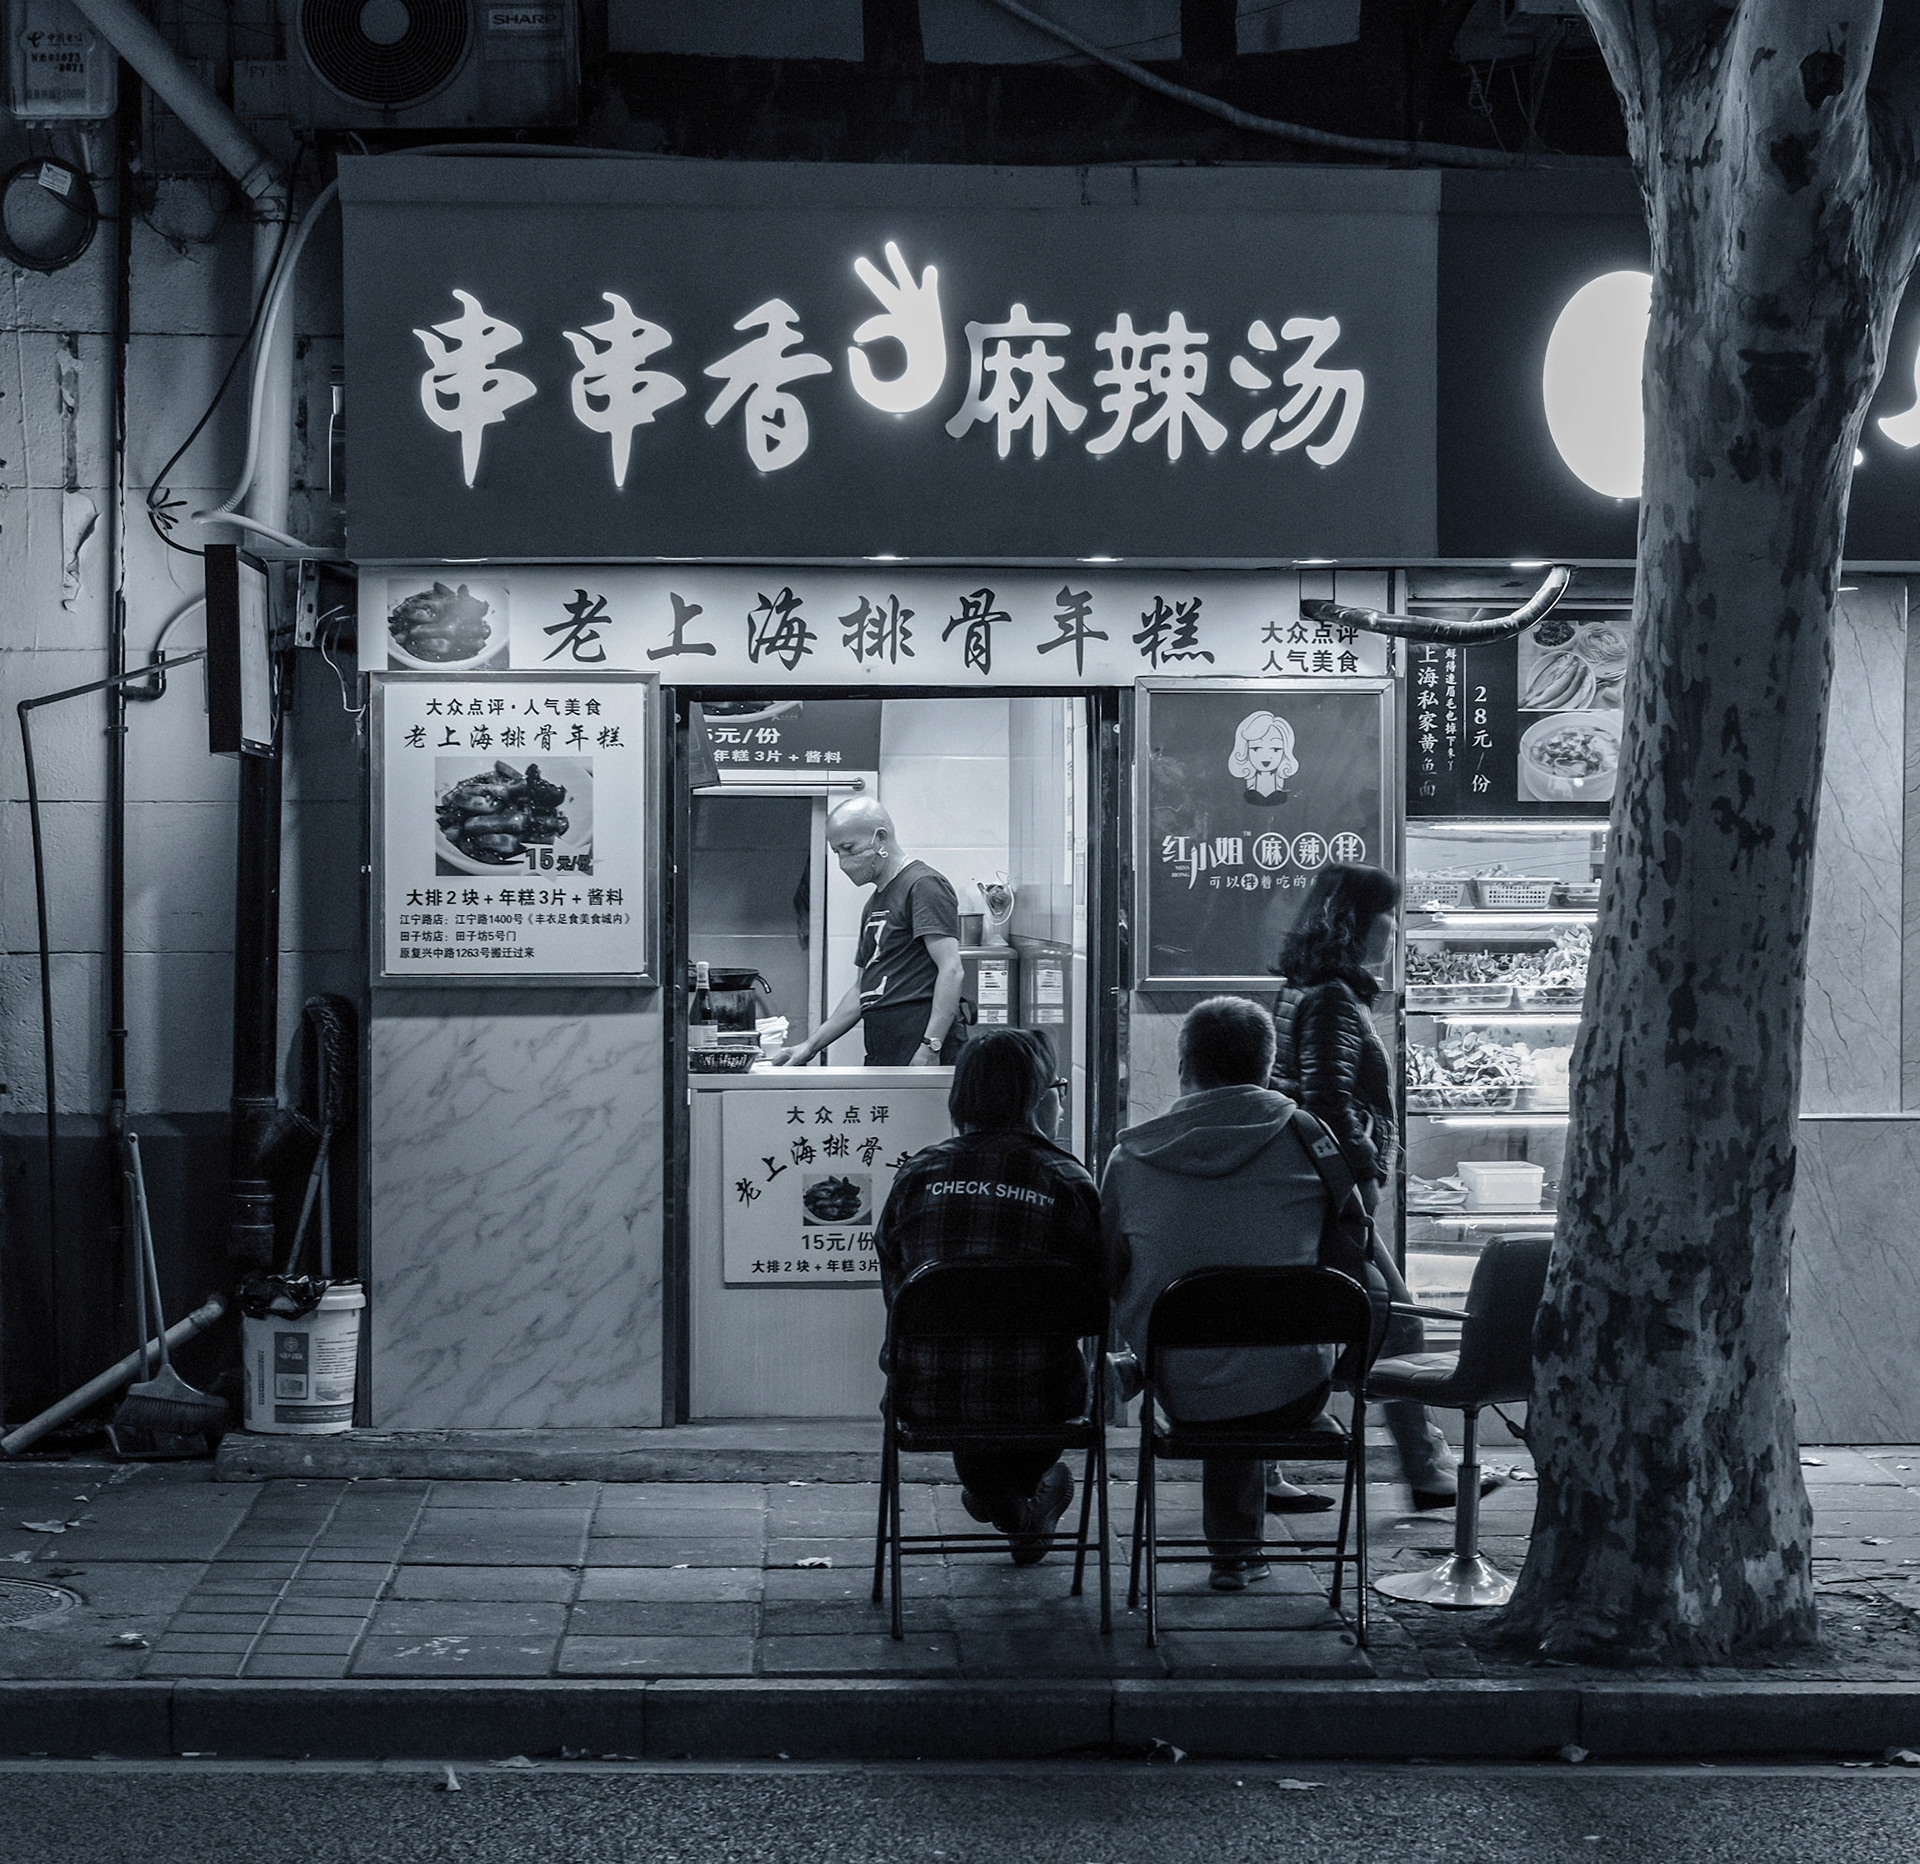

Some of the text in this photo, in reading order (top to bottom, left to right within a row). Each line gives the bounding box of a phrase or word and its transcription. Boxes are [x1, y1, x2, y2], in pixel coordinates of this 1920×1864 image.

[492, 14, 557, 25] SHARP
[413, 288, 1365, 487] 串串香 麻辣汤
[542, 585, 1215, 676] 老上海排骨年糕
[1261, 620, 1359, 645] 大众点评
[1261, 650, 1359, 673] 人气美食
[1417, 645, 1439, 796] 上海私家黄鱼面
[404, 723, 625, 751] 老上海排骨年糕
[525, 848, 591, 871] 15元/份
[1162, 835, 1244, 889] 红小姐
[1256, 835, 1362, 868] 麻辣拌
[1210, 874, 1318, 890] 可以拌着吃的
[787, 1105, 889, 1124] 大众点评
[802, 1232, 874, 1251] 15元/份
